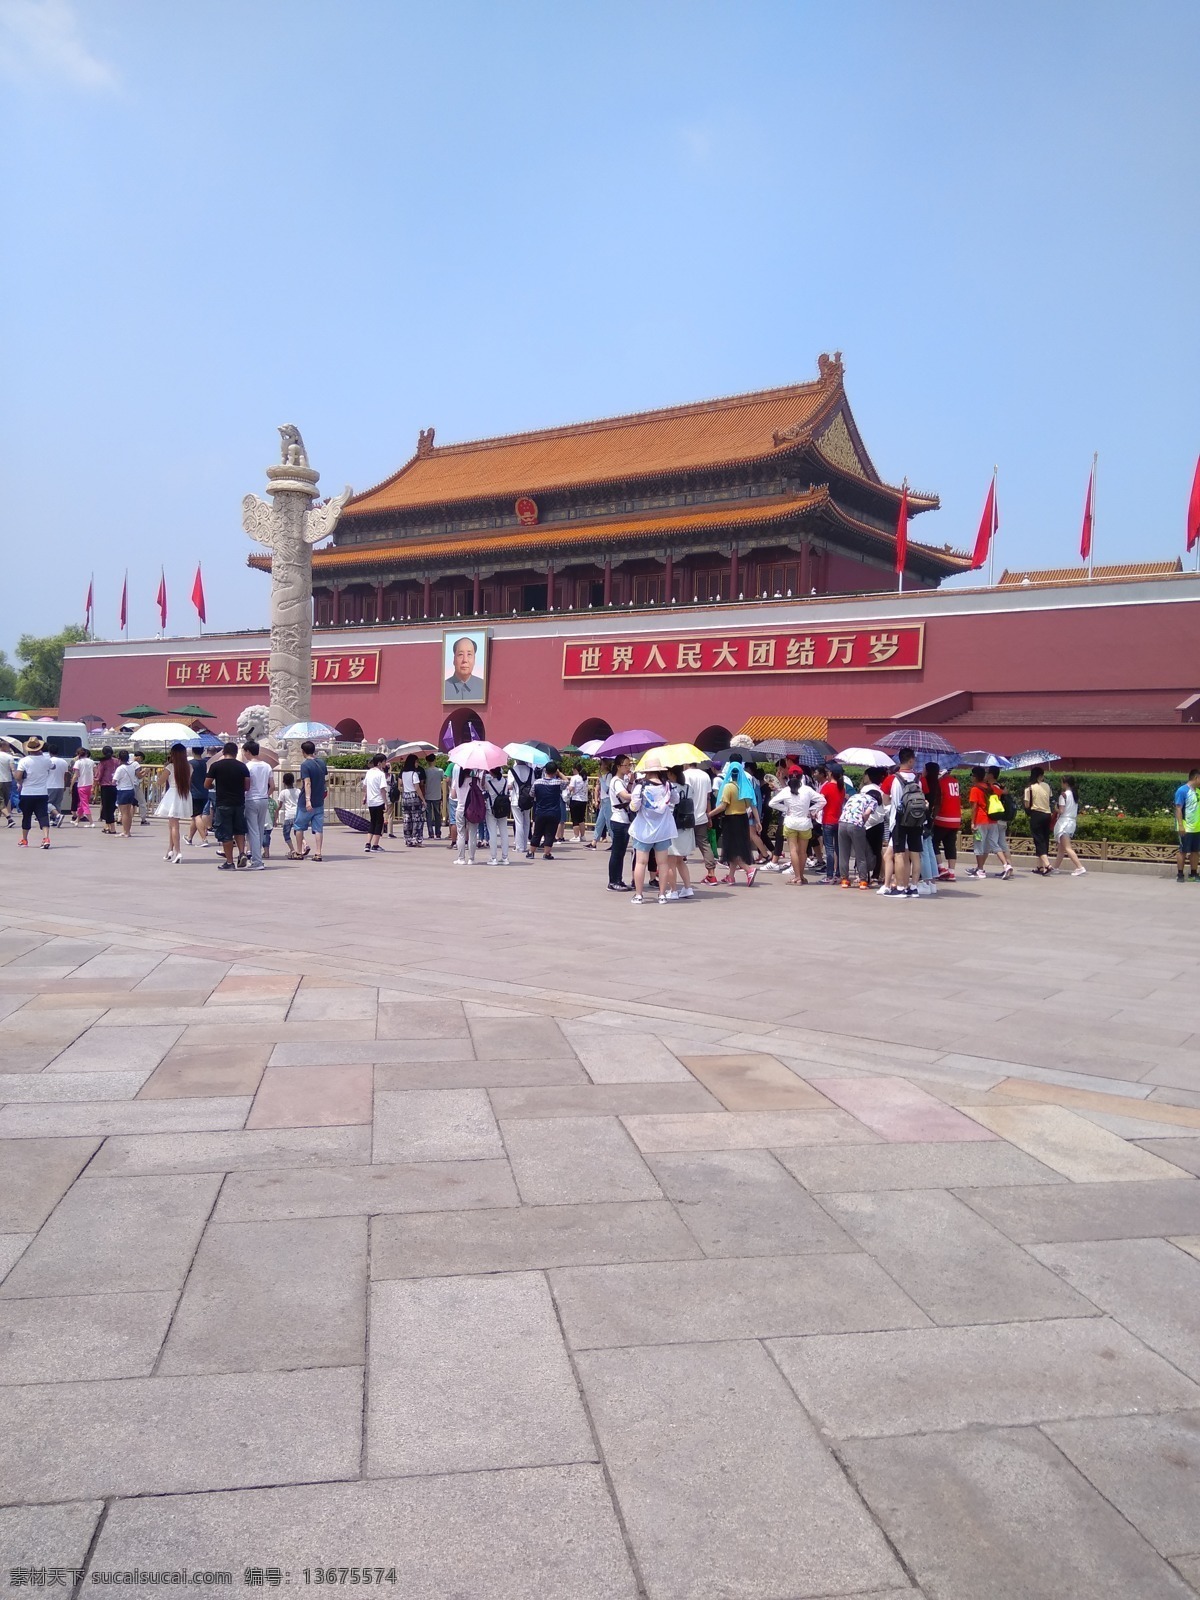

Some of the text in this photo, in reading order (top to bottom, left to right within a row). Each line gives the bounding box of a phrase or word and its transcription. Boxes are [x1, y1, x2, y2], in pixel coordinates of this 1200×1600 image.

[579, 633, 900, 673] 世界人民大团结万岁
